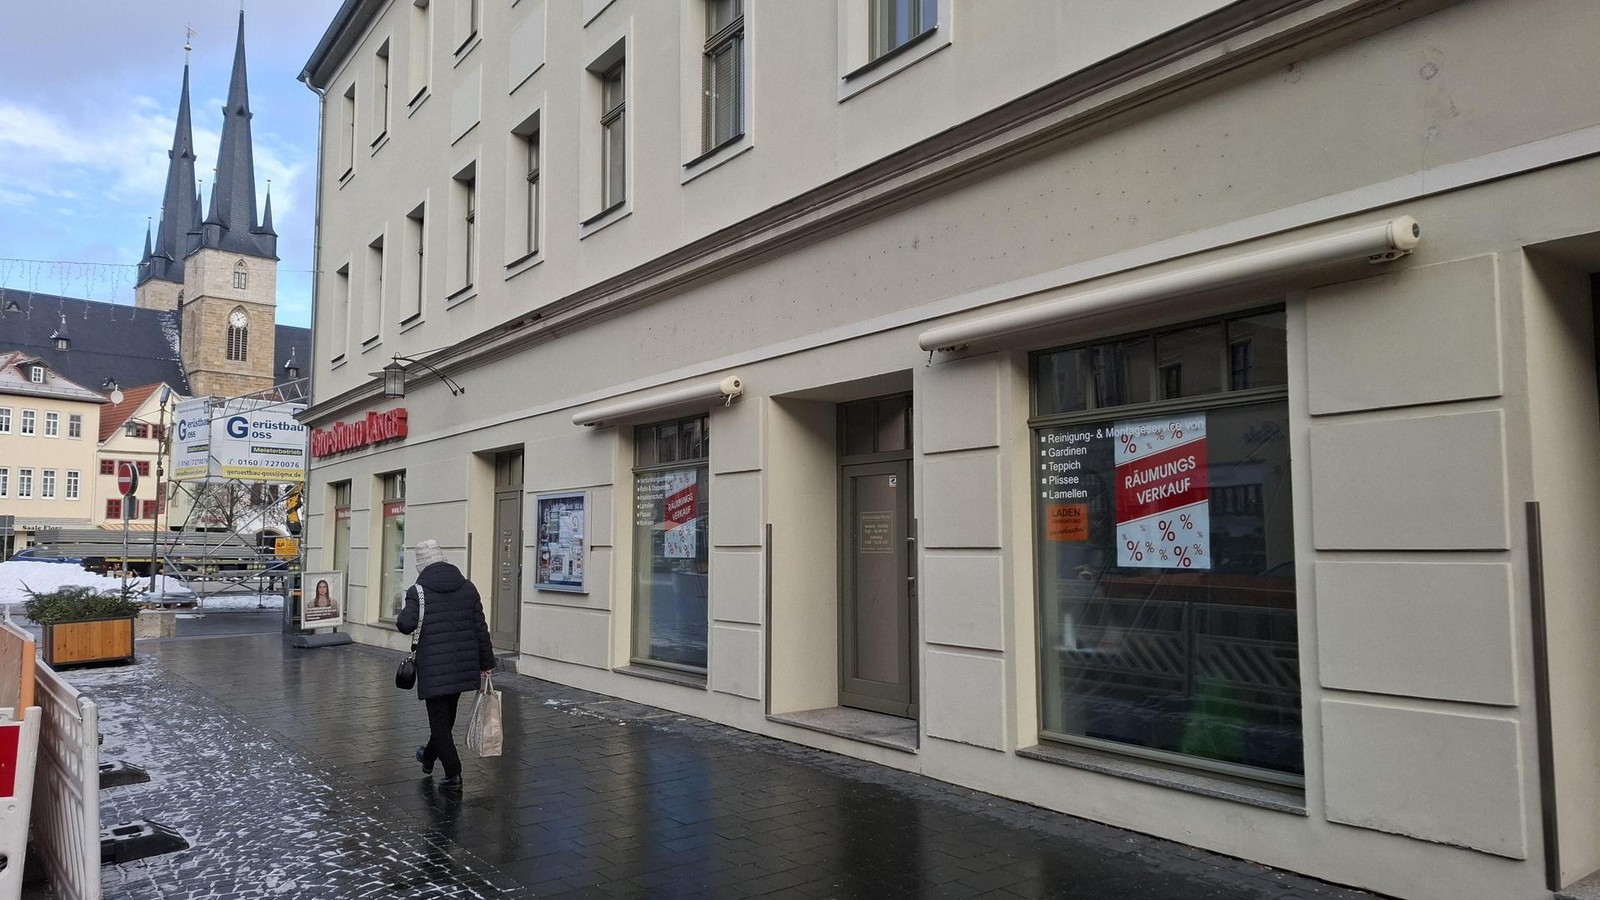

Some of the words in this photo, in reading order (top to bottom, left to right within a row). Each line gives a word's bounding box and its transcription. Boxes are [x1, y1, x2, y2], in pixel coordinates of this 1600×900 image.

[1048, 431, 1094, 443] Reinigung-
[1096, 429, 1103, 439] &
[1105, 422, 1181, 438] Montageservice
[1185, 420, 1204, 429] von
[253, 447, 302, 455] Meisterbetrieb
[1048, 446, 1087, 457] Gardinen
[1049, 461, 1081, 472] Teppich
[1125, 455, 1196, 489] RÄUMUNGS
[1049, 475, 1079, 485] Plissee
[1049, 489, 1087, 499] Lamellen
[1137, 477, 1191, 504] VERKAUF
[1051, 507, 1080, 516] LADEN
